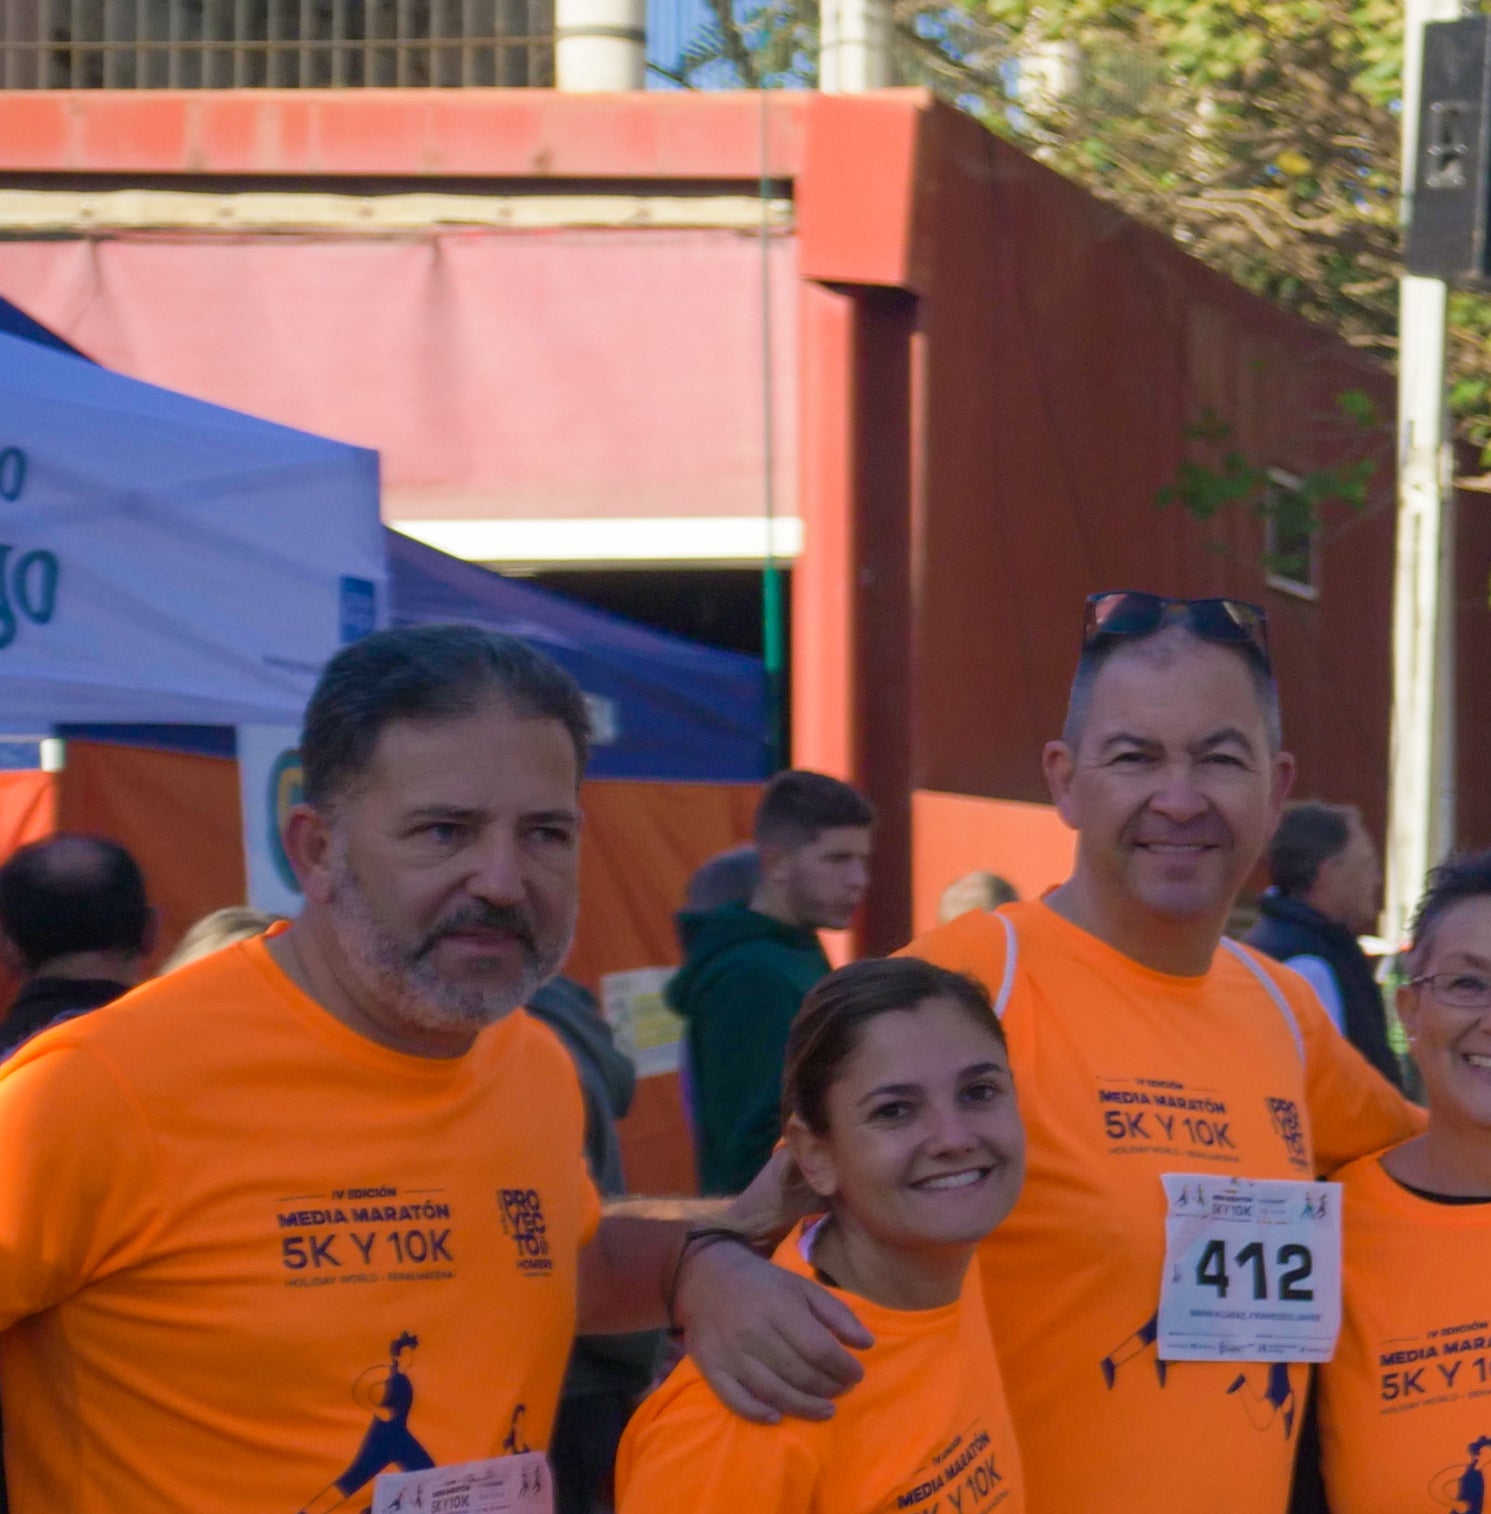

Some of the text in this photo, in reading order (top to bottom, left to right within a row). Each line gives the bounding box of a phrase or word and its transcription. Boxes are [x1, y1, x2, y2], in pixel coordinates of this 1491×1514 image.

[1099, 1089, 1226, 1114] MEDIA MARATÓN
[1105, 1110, 1236, 1150] 5K Y 10K
[278, 1201, 449, 1228] MEDIA MARATÓN
[503, 1189, 540, 1211] PRO
[283, 1229, 453, 1270] 5K Y 10K
[1196, 1240, 1314, 1302] 412
[1380, 1346, 1438, 1366] MEDIA
[1382, 1367, 1425, 1400] 5K
[1437, 1360, 1462, 1388] Y
[897, 1474, 944, 1510] MEDIA
[945, 1430, 990, 1480] MARATÓN
[966, 1453, 1002, 1504] 10K
